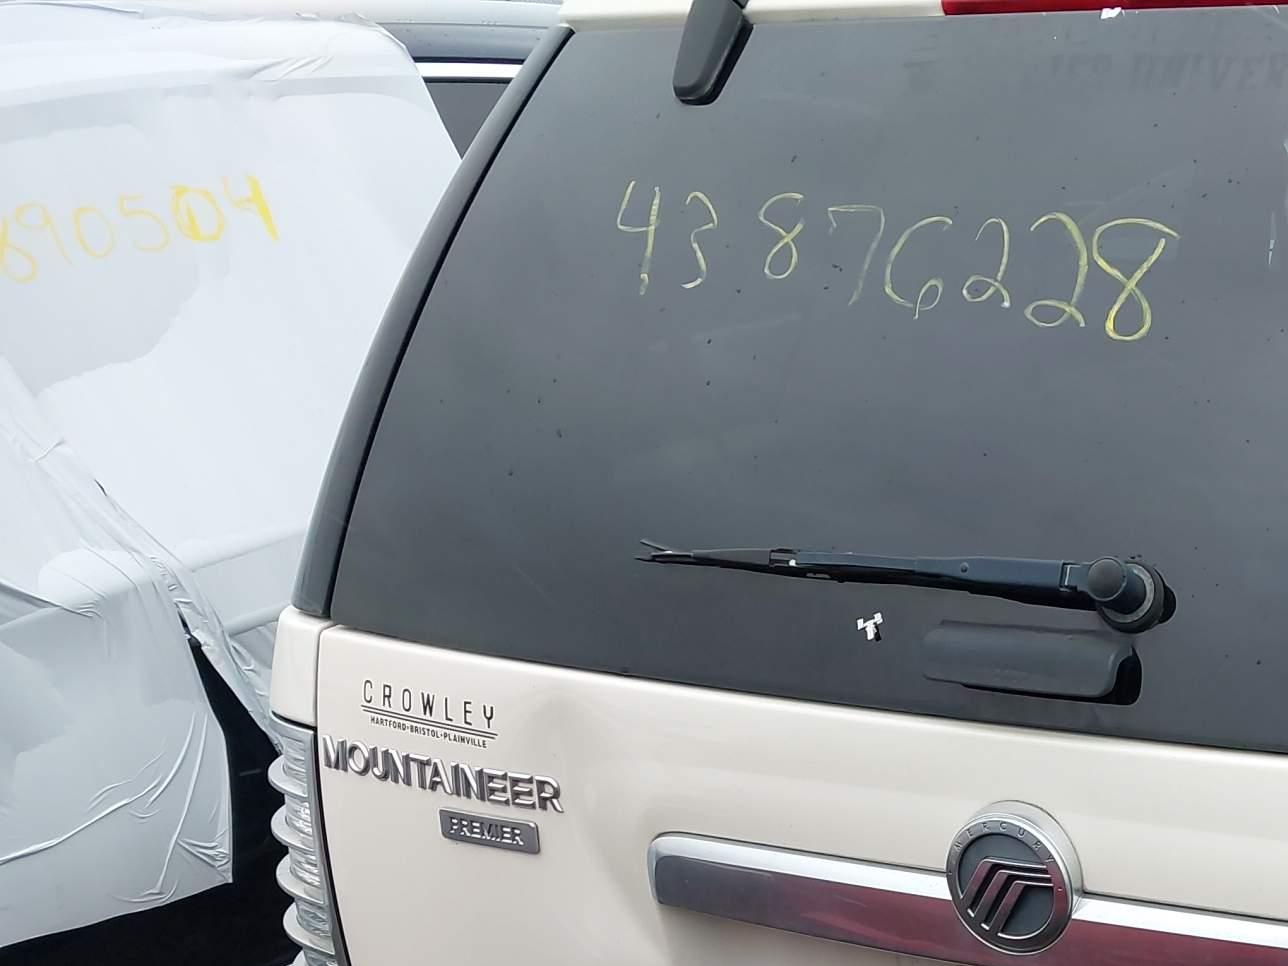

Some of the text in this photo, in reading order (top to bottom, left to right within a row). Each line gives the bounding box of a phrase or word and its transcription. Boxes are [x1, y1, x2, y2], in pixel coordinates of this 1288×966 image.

[616, 180, 1182, 341] 43876228
[363, 680, 496, 730] CROWLEY
[321, 734, 565, 814] MOUNTAINEER
[448, 816, 525, 846] PREMIER
[953, 821, 1056, 864] MERCURY
